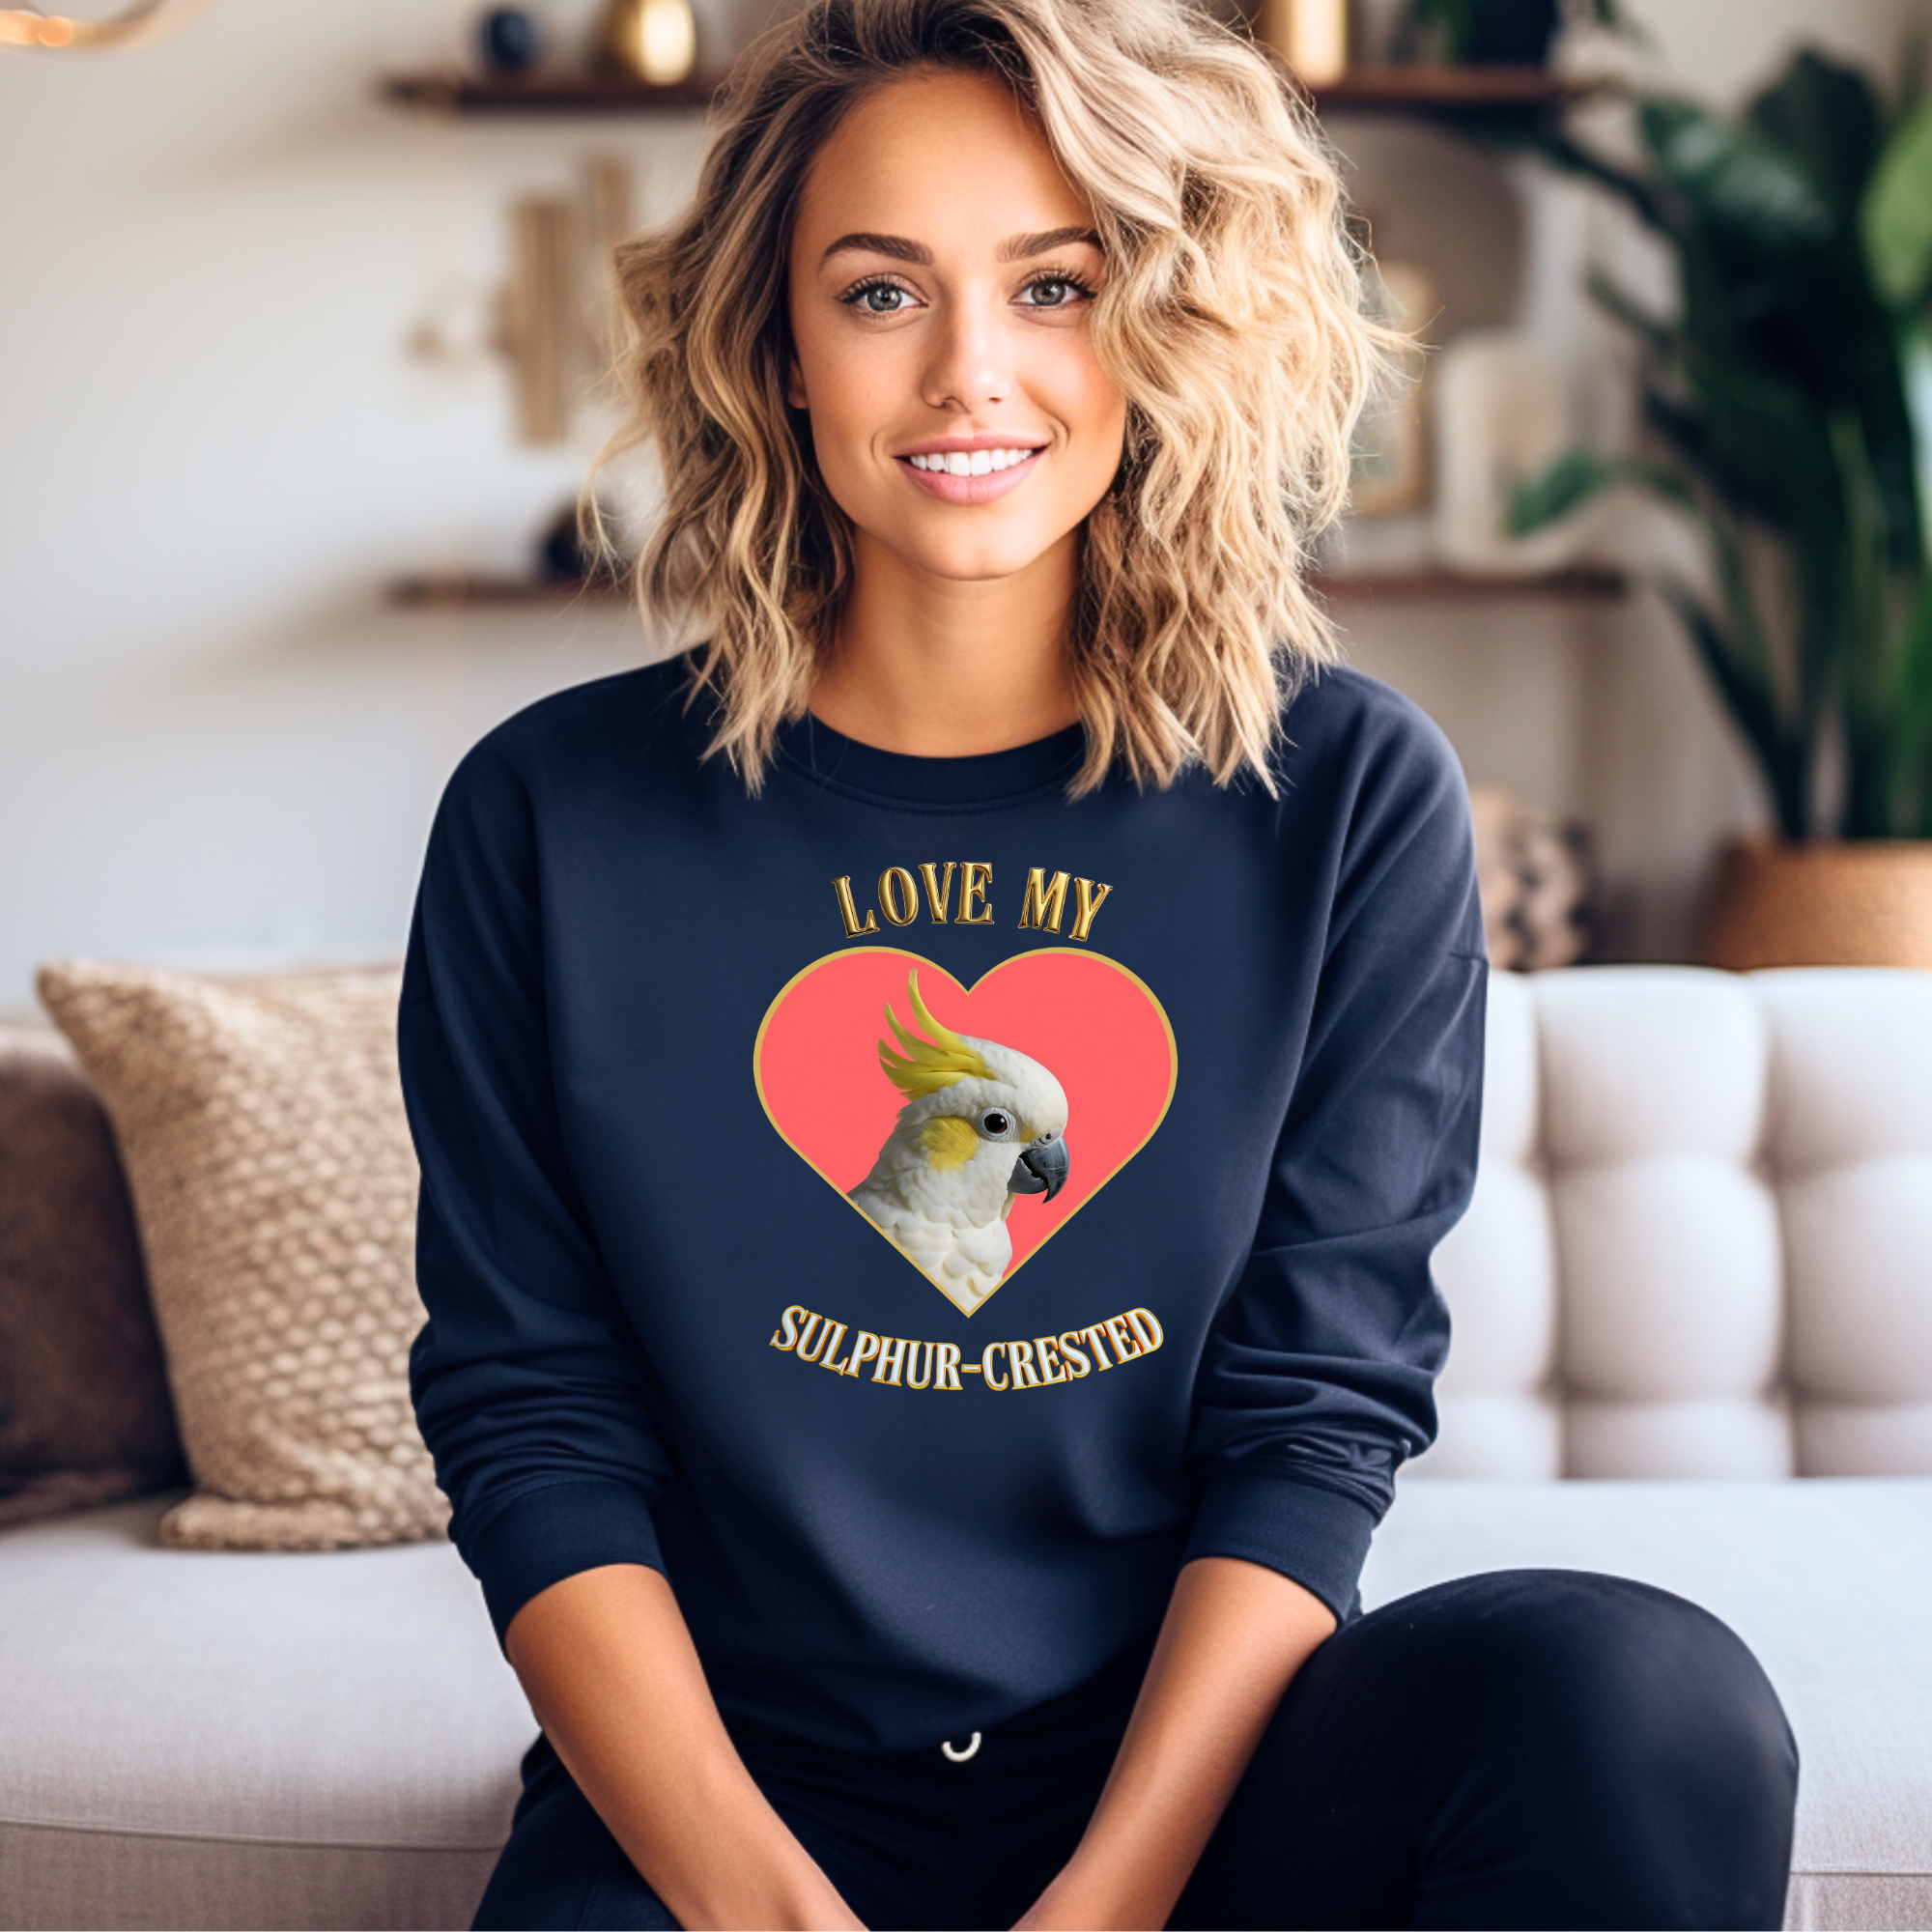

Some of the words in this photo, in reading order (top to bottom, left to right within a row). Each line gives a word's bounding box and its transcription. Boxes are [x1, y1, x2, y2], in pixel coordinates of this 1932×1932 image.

[831, 862, 995, 938] LOVE
[1017, 867, 1114, 942] MY
[769, 1305, 1164, 1391] SULPHUR-CRESTED
